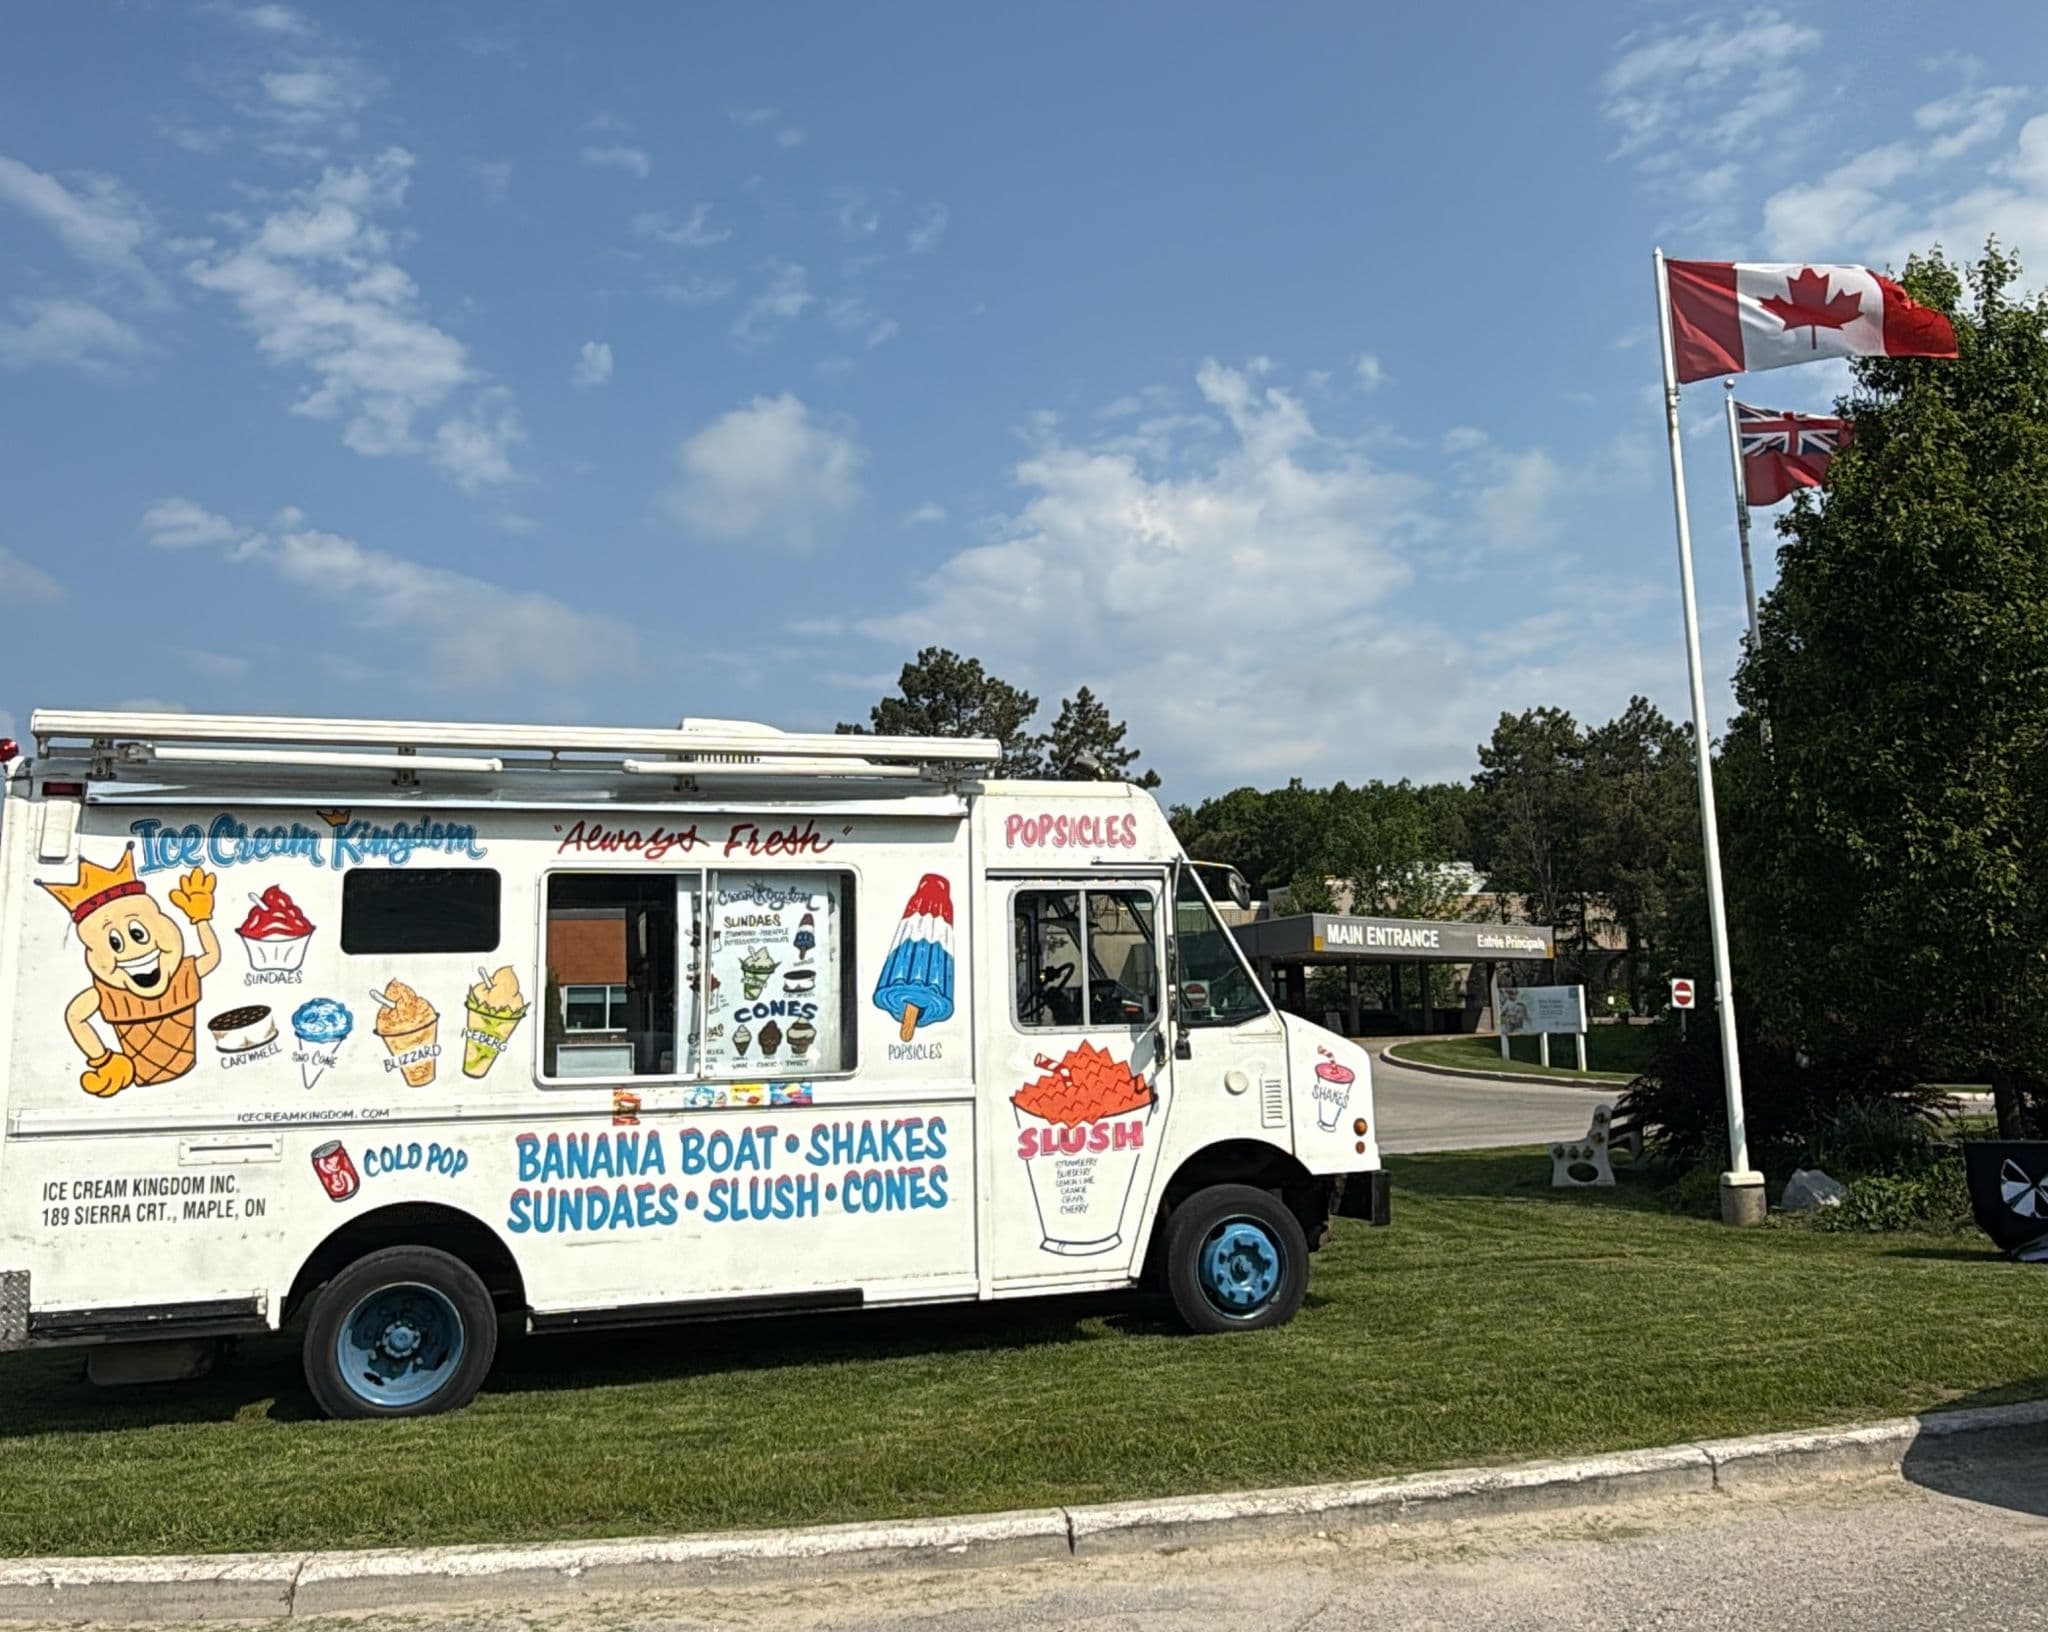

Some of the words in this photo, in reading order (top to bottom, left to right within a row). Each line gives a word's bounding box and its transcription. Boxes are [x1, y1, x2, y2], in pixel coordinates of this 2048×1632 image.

[131, 818, 207, 876] Ice
[207, 812, 326, 868] Cream
[330, 815, 488, 871] Kingdom
[1005, 814, 1137, 849] POPSICLES
[723, 914, 782, 928] SUNDAES
[1326, 924, 1364, 945] MAIN
[1366, 926, 1440, 949] ENTRANCE
[1505, 935, 1546, 952] Principale
[243, 969, 303, 986] SUNDAES
[734, 1000, 819, 1023] CONES
[460, 1028, 508, 1052] ICEBERG
[888, 1042, 943, 1061] POPSICLES
[220, 1041, 283, 1070] CARTWHEEL
[383, 1044, 442, 1073] BLIZZARD
[1312, 1084, 1350, 1109] SHAKES
[516, 1130, 666, 1183] BANANA
[680, 1125, 778, 1175] BOAT
[805, 1116, 948, 1166] SHAKES
[1017, 1120, 1144, 1160] SLUSH
[363, 1143, 422, 1178] COLD
[426, 1143, 468, 1178] POP
[43, 1182, 68, 1201] ICE
[72, 1179, 127, 1200] CREAM
[133, 1176, 205, 1198] KINGDOM
[209, 1175, 241, 1195] INC.
[507, 1183, 679, 1234] SUNDAES
[703, 1172, 819, 1223] SLUSH
[842, 1164, 949, 1213] CONES
[42, 1206, 70, 1226] 189
[74, 1204, 131, 1225] SIERRA
[135, 1202, 178, 1224] CRT.,
[183, 1200, 239, 1221] MAPLE,
[245, 1198, 266, 1218] ON
